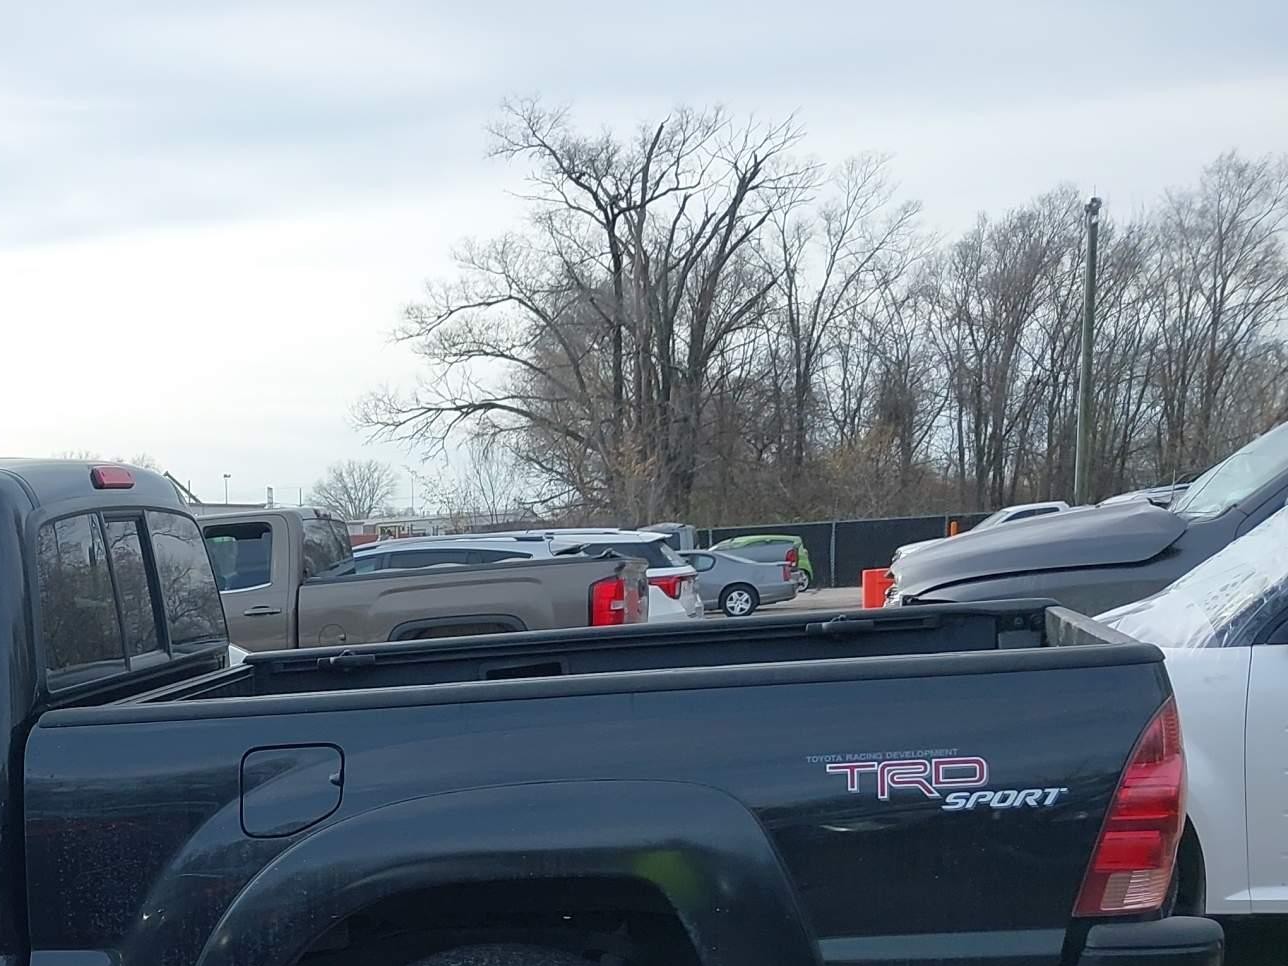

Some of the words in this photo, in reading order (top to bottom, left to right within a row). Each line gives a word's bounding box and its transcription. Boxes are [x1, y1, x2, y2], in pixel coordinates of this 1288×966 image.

[806, 754, 842, 763] TOYOTA
[846, 752, 883, 761] RACING
[886, 748, 959, 760] DEVELOPMENT
[826, 757, 989, 799] TRD
[941, 788, 1068, 810] SPORT
